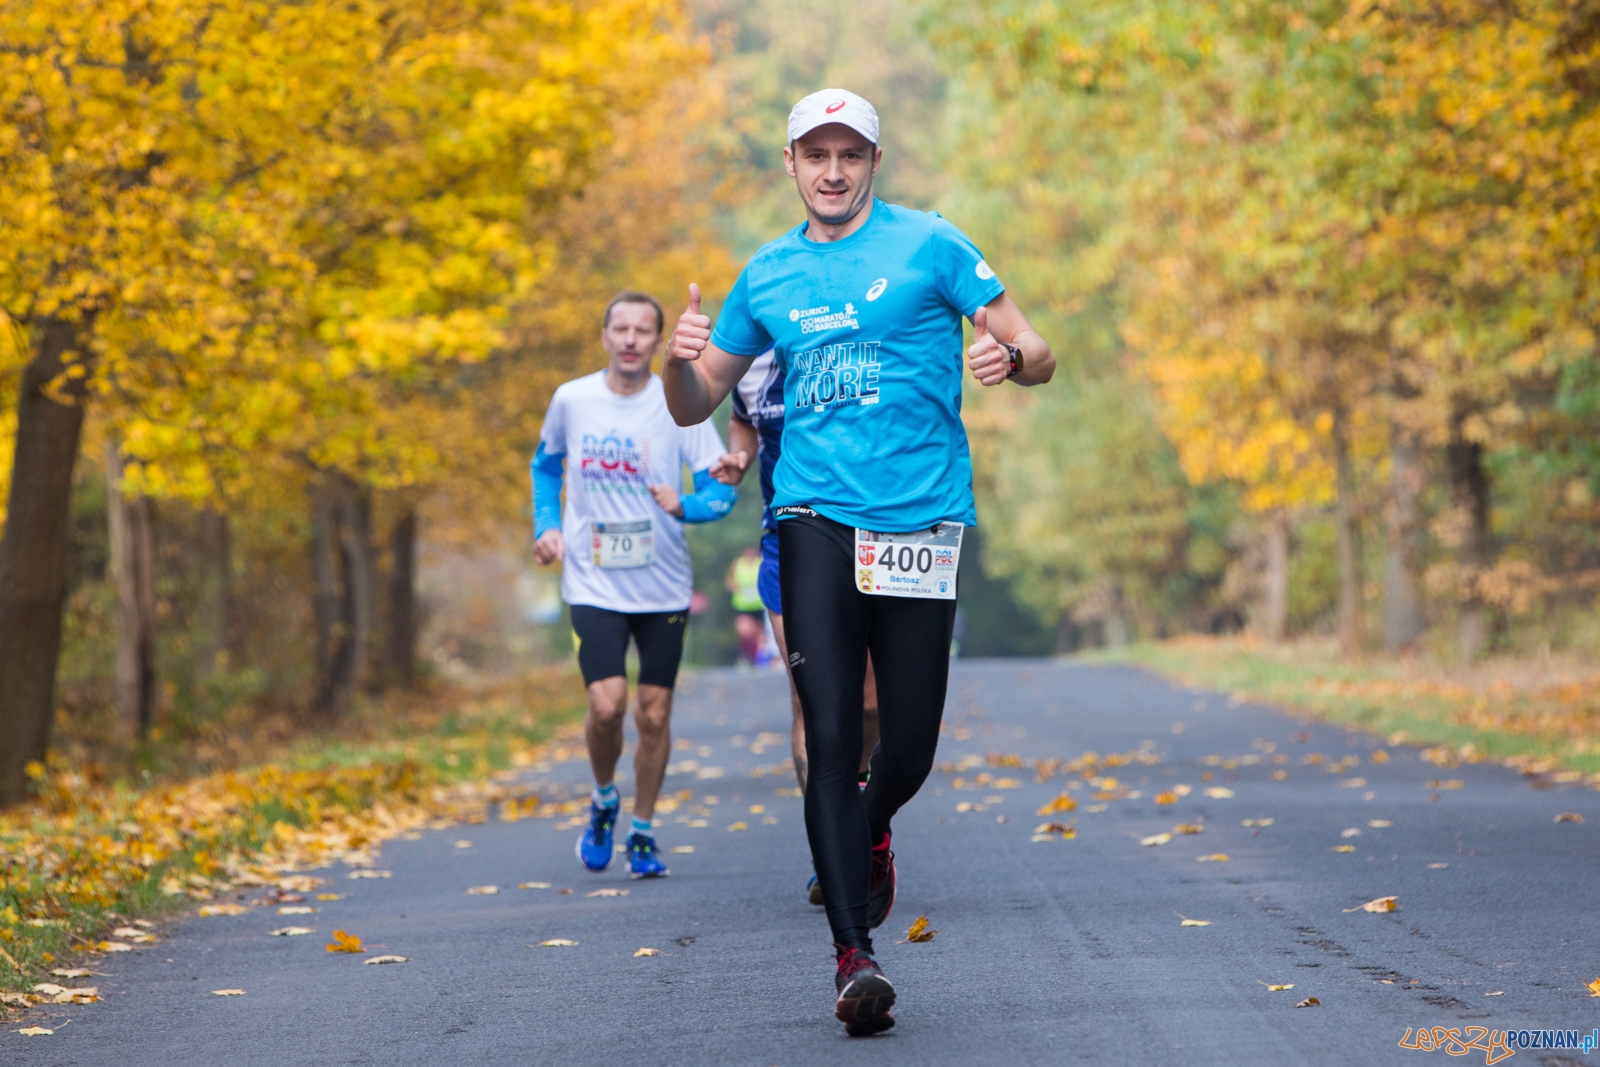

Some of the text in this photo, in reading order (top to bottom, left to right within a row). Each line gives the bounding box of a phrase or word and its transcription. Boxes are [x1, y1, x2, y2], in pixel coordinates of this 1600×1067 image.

[800, 306, 830, 318] ZURICH
[815, 318, 858, 332] BARCELONA
[858, 341, 881, 364] IT
[795, 363, 881, 408] MORE
[825, 400, 859, 411] MARATHON
[860, 396, 879, 406] 2016
[582, 446, 640, 462] MARATON
[609, 535, 633, 553] 70
[878, 545, 932, 574] 400
[889, 575, 920, 584] Bartosz
[881, 585, 910, 593] POLINOVA
